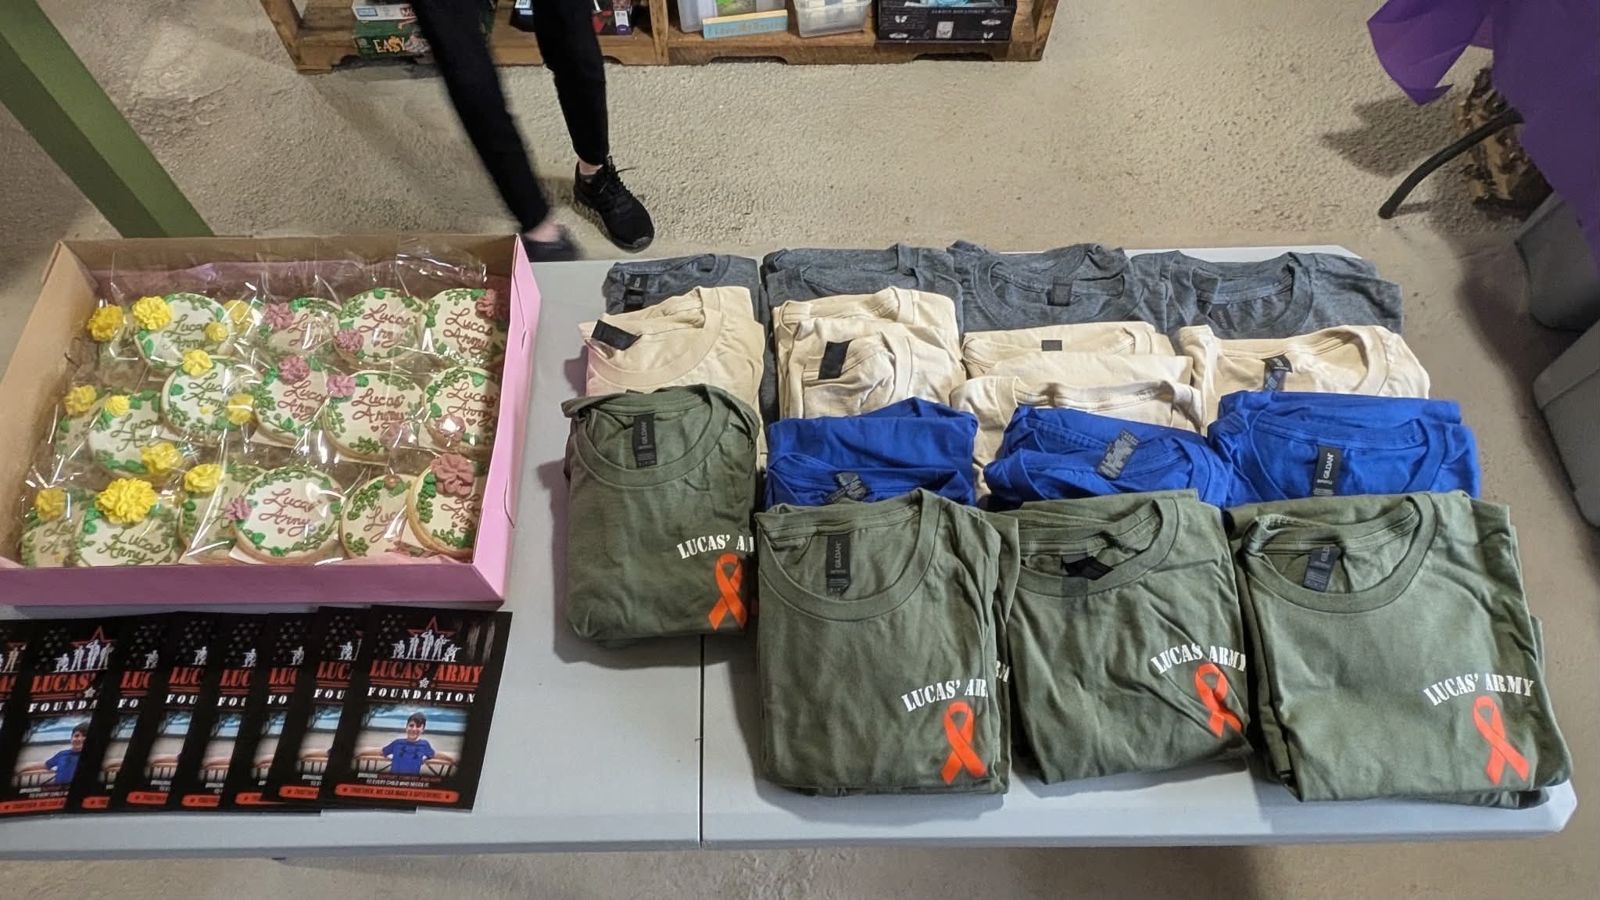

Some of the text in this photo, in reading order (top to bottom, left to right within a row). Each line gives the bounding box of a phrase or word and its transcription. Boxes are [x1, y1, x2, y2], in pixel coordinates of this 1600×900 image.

[677, 534, 731, 559] LUCAS'
[120, 671, 151, 688] LUC
[169, 666, 201, 684] LUC
[219, 669, 250, 687] LUC
[268, 667, 298, 685] LUC
[316, 661, 347, 680] LUC
[433, 664, 483, 683] ARMY
[367, 686, 476, 703] FOUNDATION
[901, 678, 988, 712] LUCAS' AR
[1423, 672, 1534, 706] LUCAS' ARMY
[28, 699, 98, 713] FOUNDA
